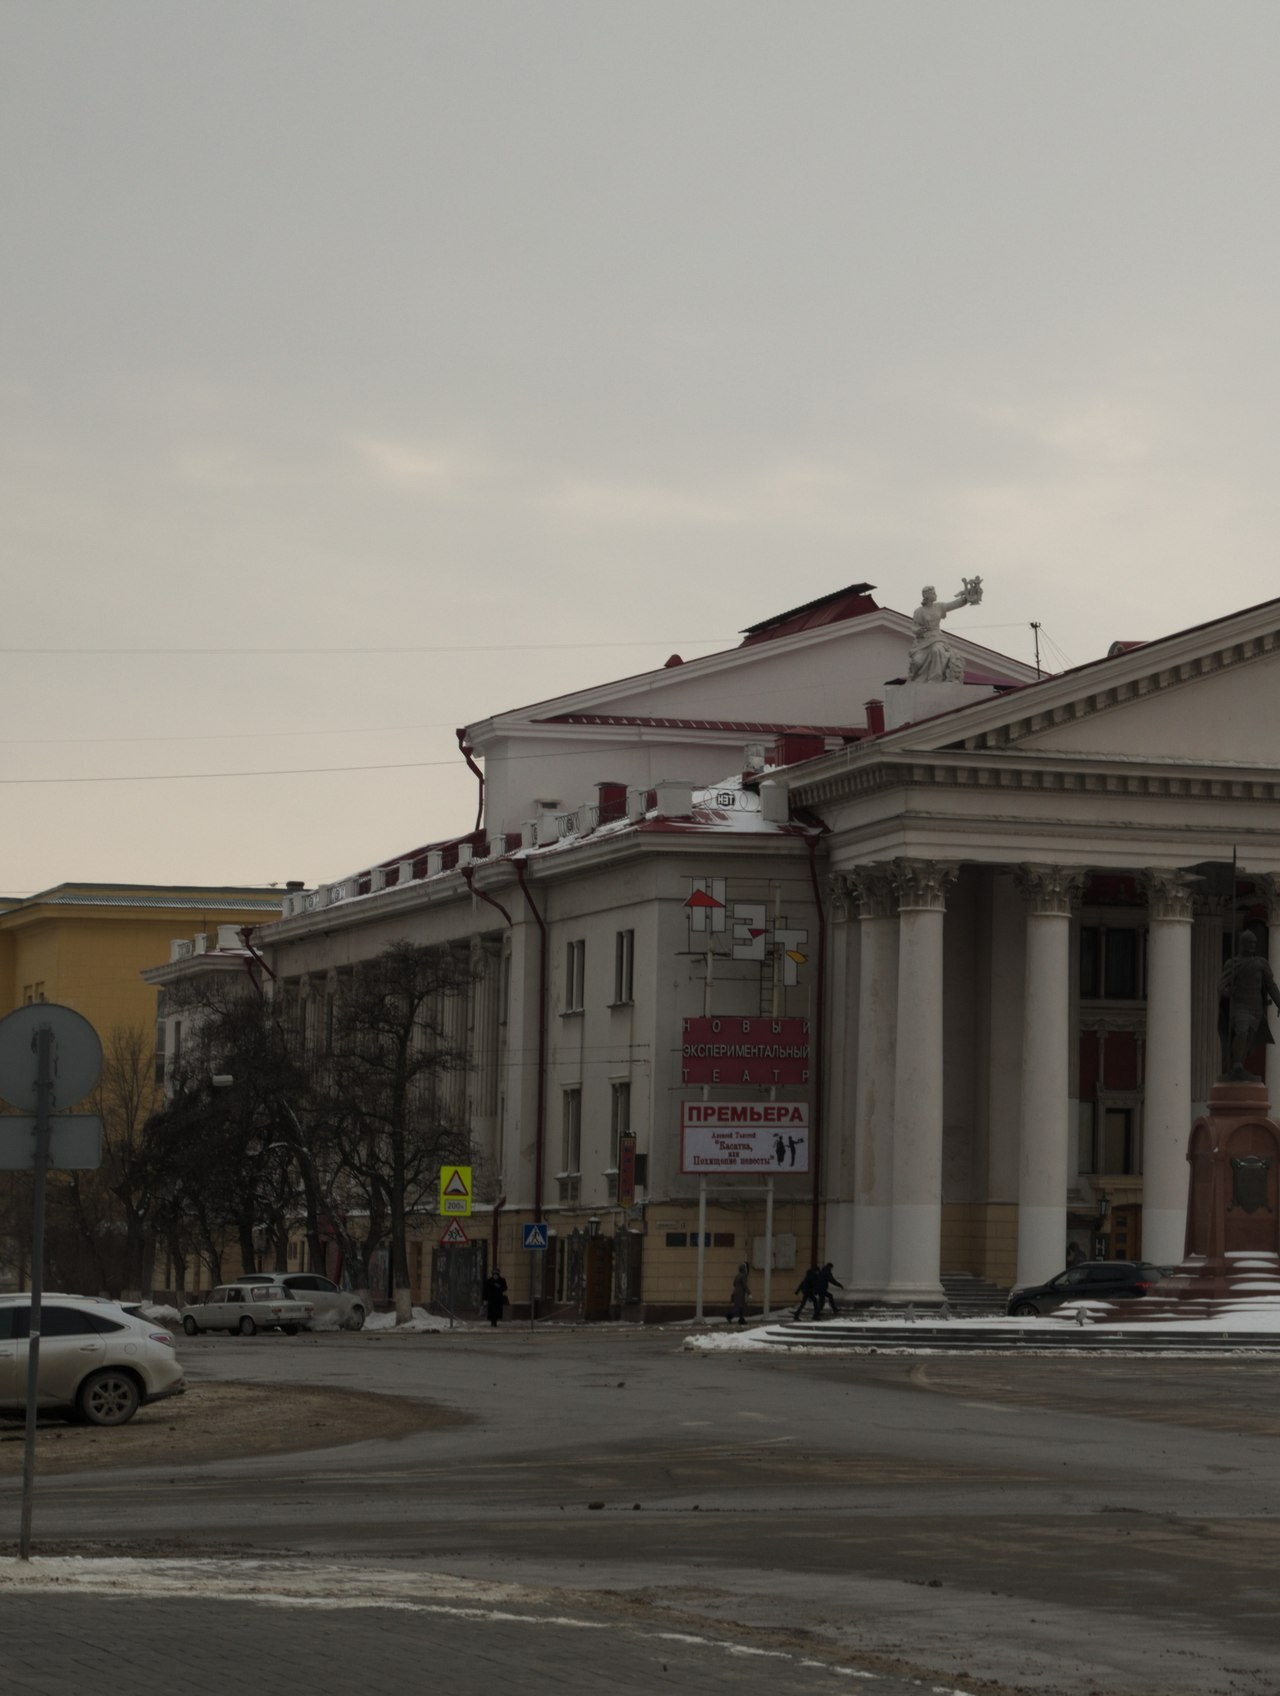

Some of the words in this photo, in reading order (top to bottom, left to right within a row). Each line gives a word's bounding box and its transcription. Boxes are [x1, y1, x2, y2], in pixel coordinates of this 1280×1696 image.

[682, 1019, 810, 1033] НОВЫЙ
[683, 1043, 810, 1058] ЭКСПЕРИМЕНТАЛЬНЫЙ
[682, 1068, 809, 1082] ТЕАТР
[688, 1106, 803, 1122] ПРЕМЬЕРА
